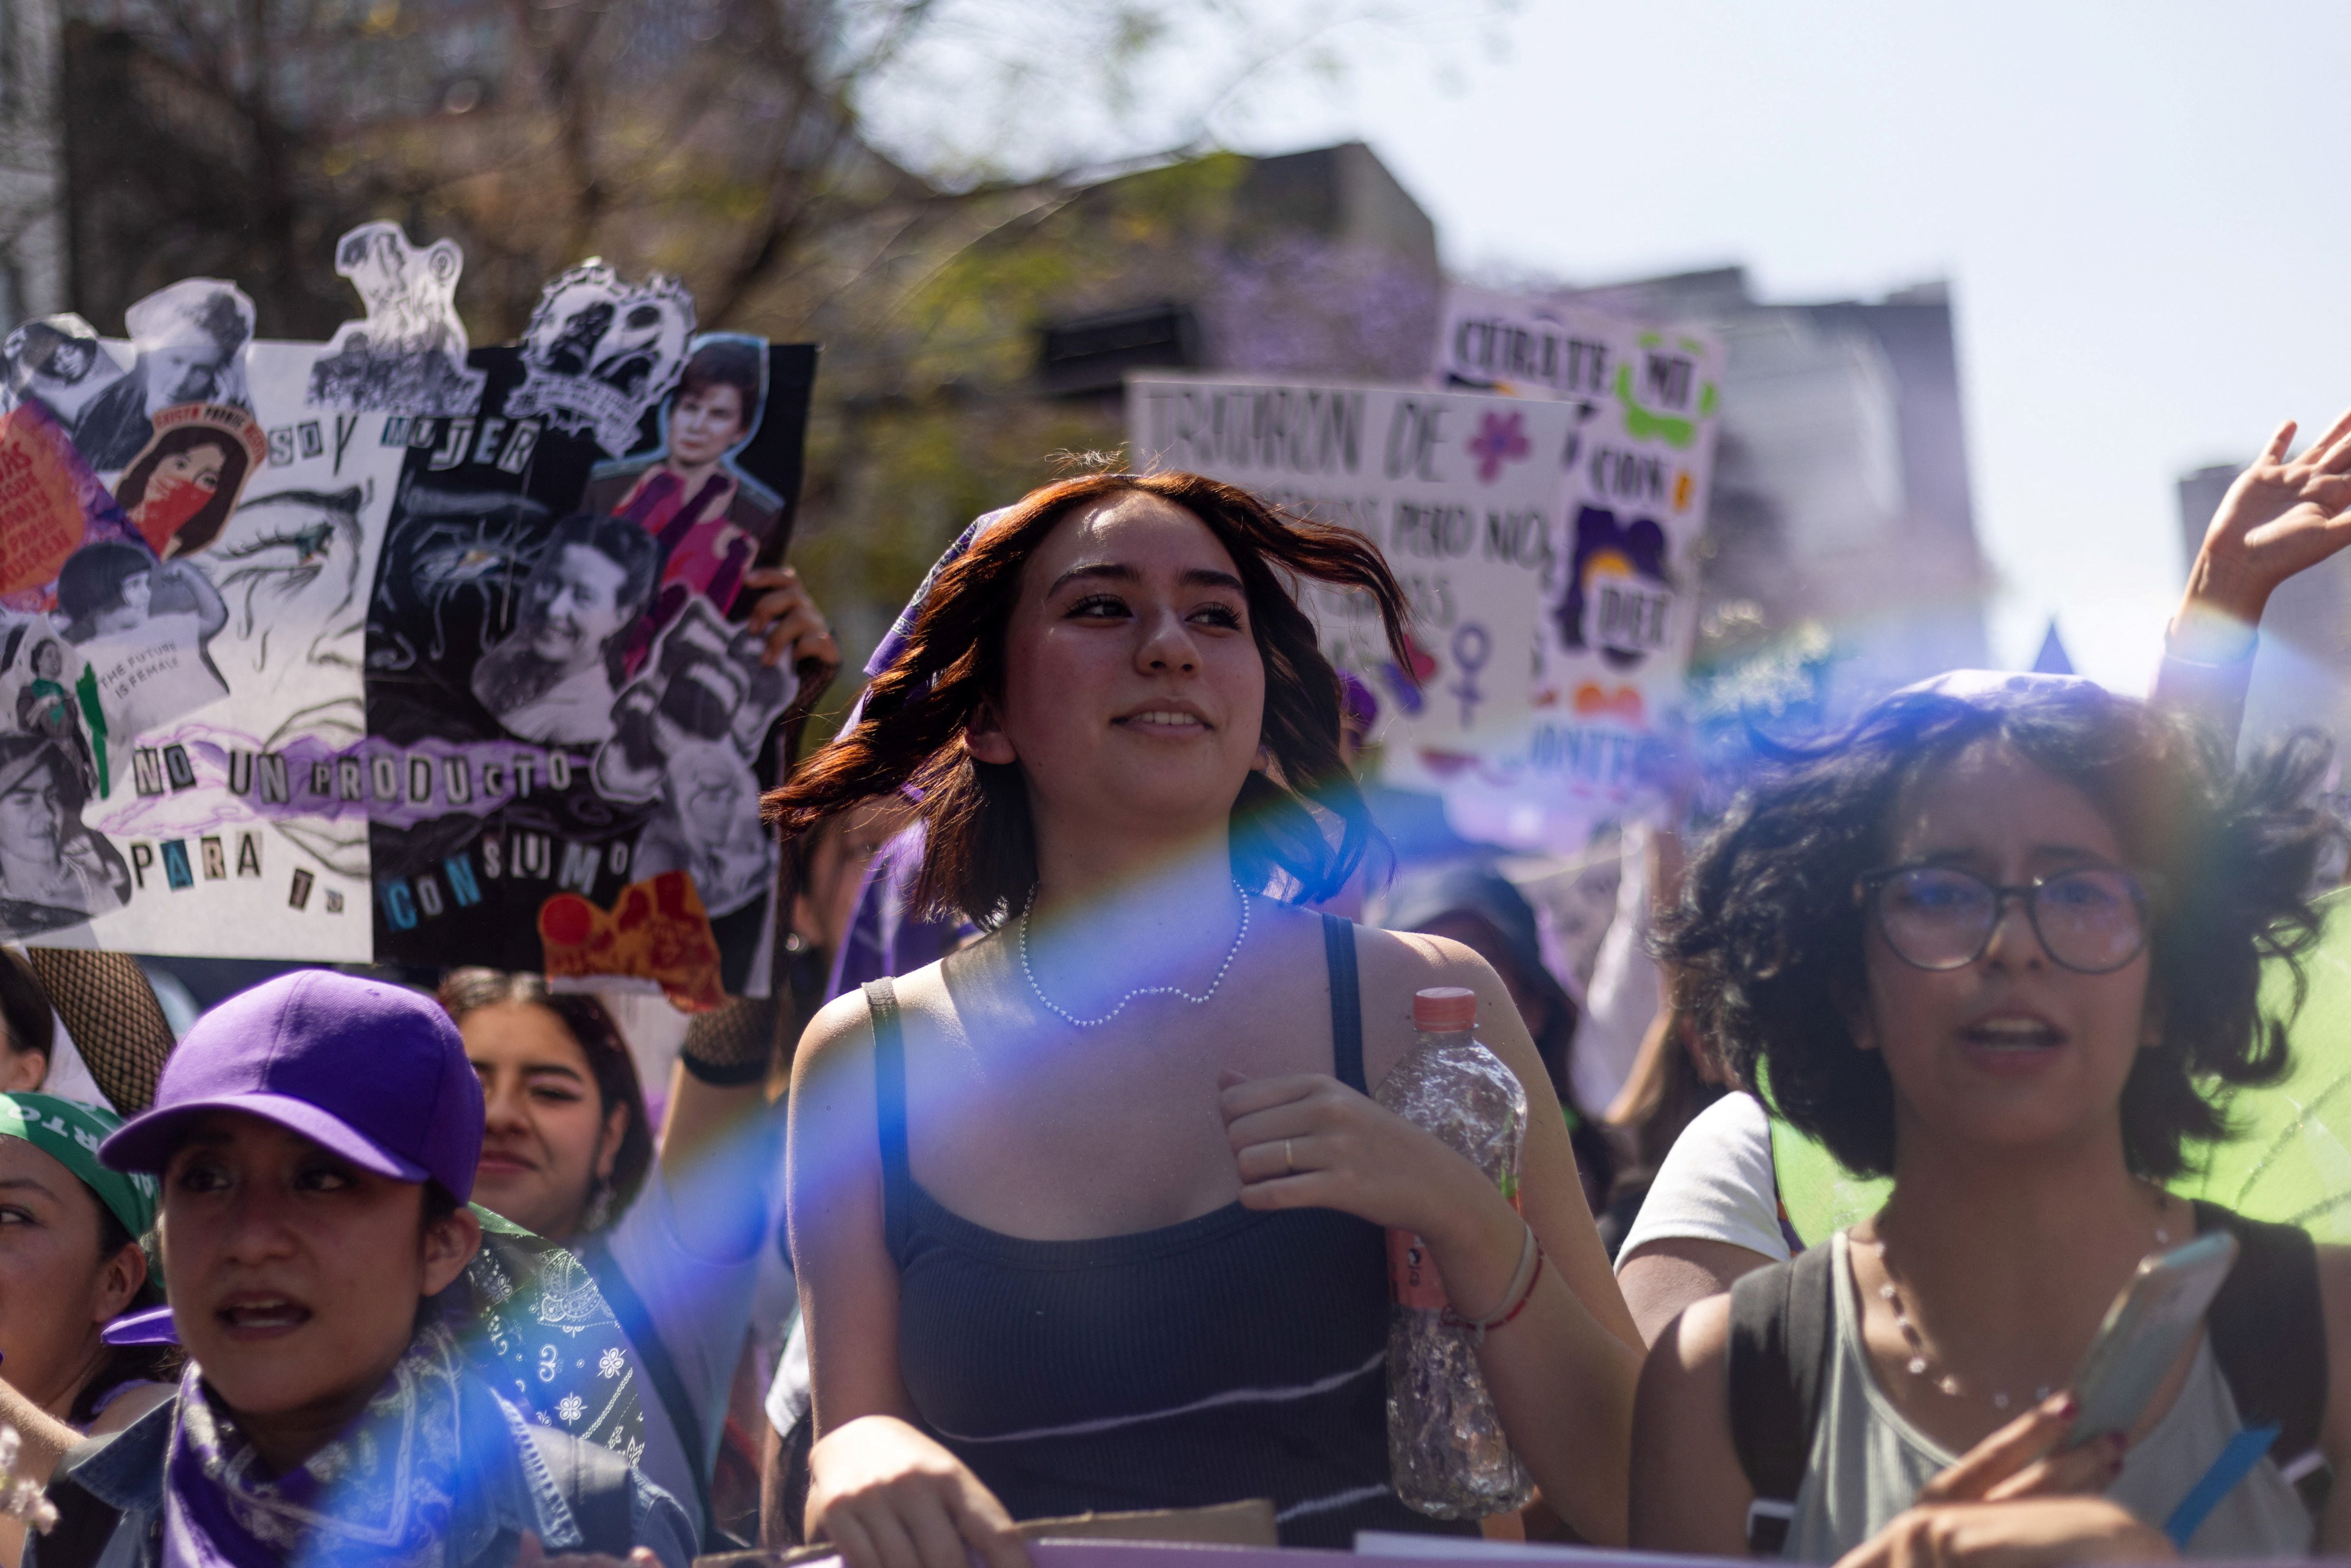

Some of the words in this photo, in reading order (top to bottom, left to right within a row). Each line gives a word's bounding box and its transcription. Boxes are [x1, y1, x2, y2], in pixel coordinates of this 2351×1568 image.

[269, 415, 359, 476] SOY
[381, 416, 541, 473] MUJER
[1385, 400, 1453, 482] DE
[1483, 509, 1547, 571] NO
[100, 663, 126, 690] THE
[127, 640, 177, 670] FUTURE
[115, 684, 128, 699] IS
[126, 657, 180, 687] FEMALE
[134, 744, 196, 797] NO
[228, 749, 289, 804] UN
[311, 750, 572, 808] PRODUCTO
[132, 833, 262, 890] PARA
[288, 868, 344, 914] TU
[386, 834, 629, 930] CONSUMO
